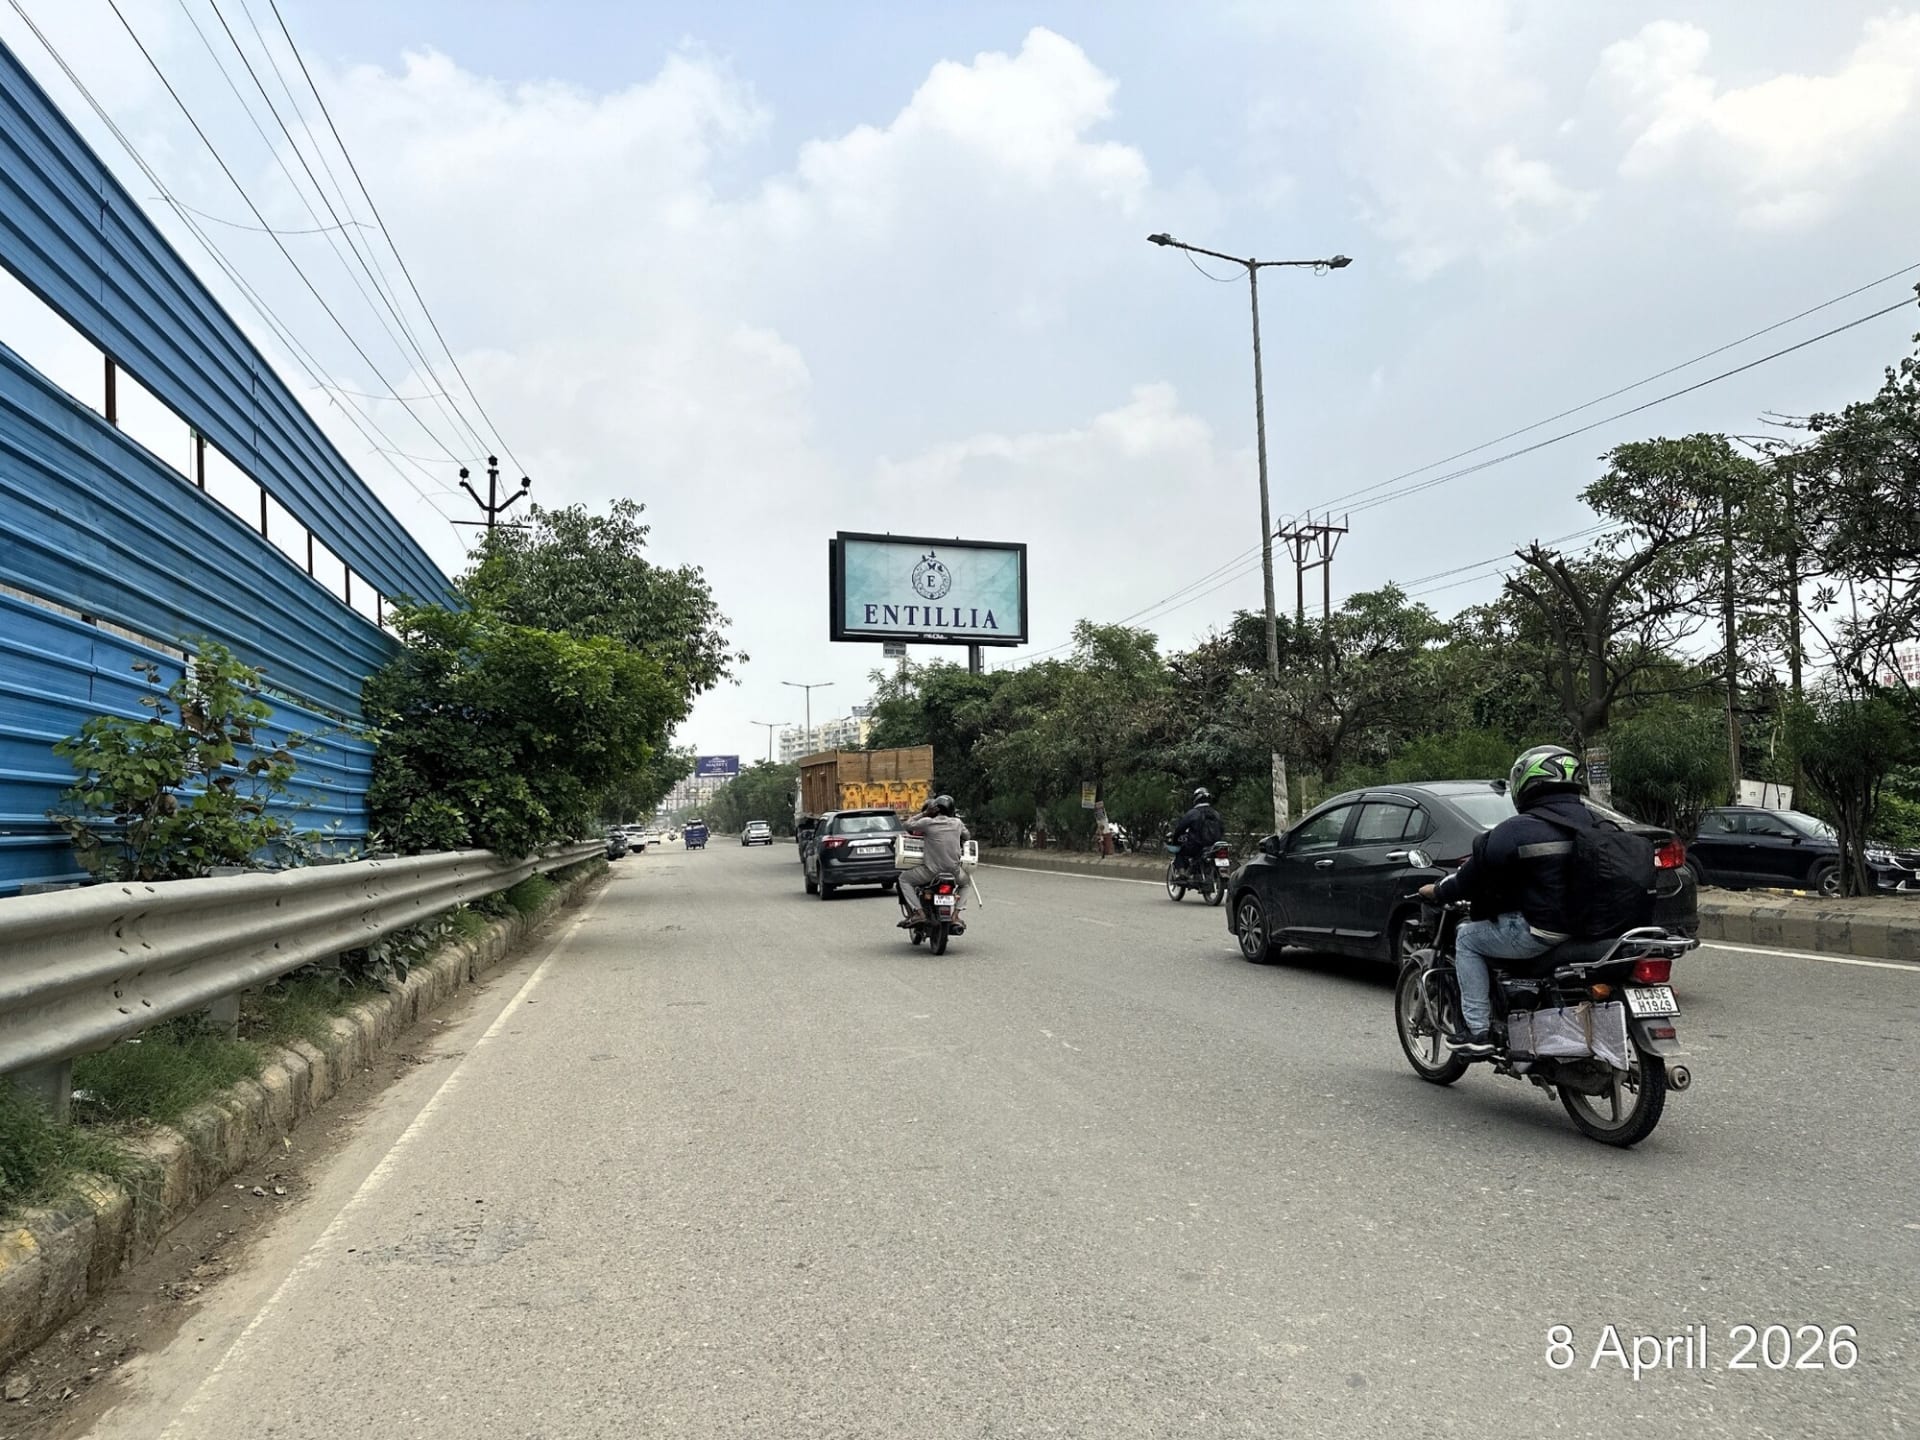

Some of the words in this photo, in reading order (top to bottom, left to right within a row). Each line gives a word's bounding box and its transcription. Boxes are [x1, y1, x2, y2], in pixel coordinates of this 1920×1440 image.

[927, 575, 936, 588] E
[864, 604, 998, 629] ENTILLIA
[1634, 988, 1668, 1000] DL3SE
[1638, 1000, 1672, 1011] H1949
